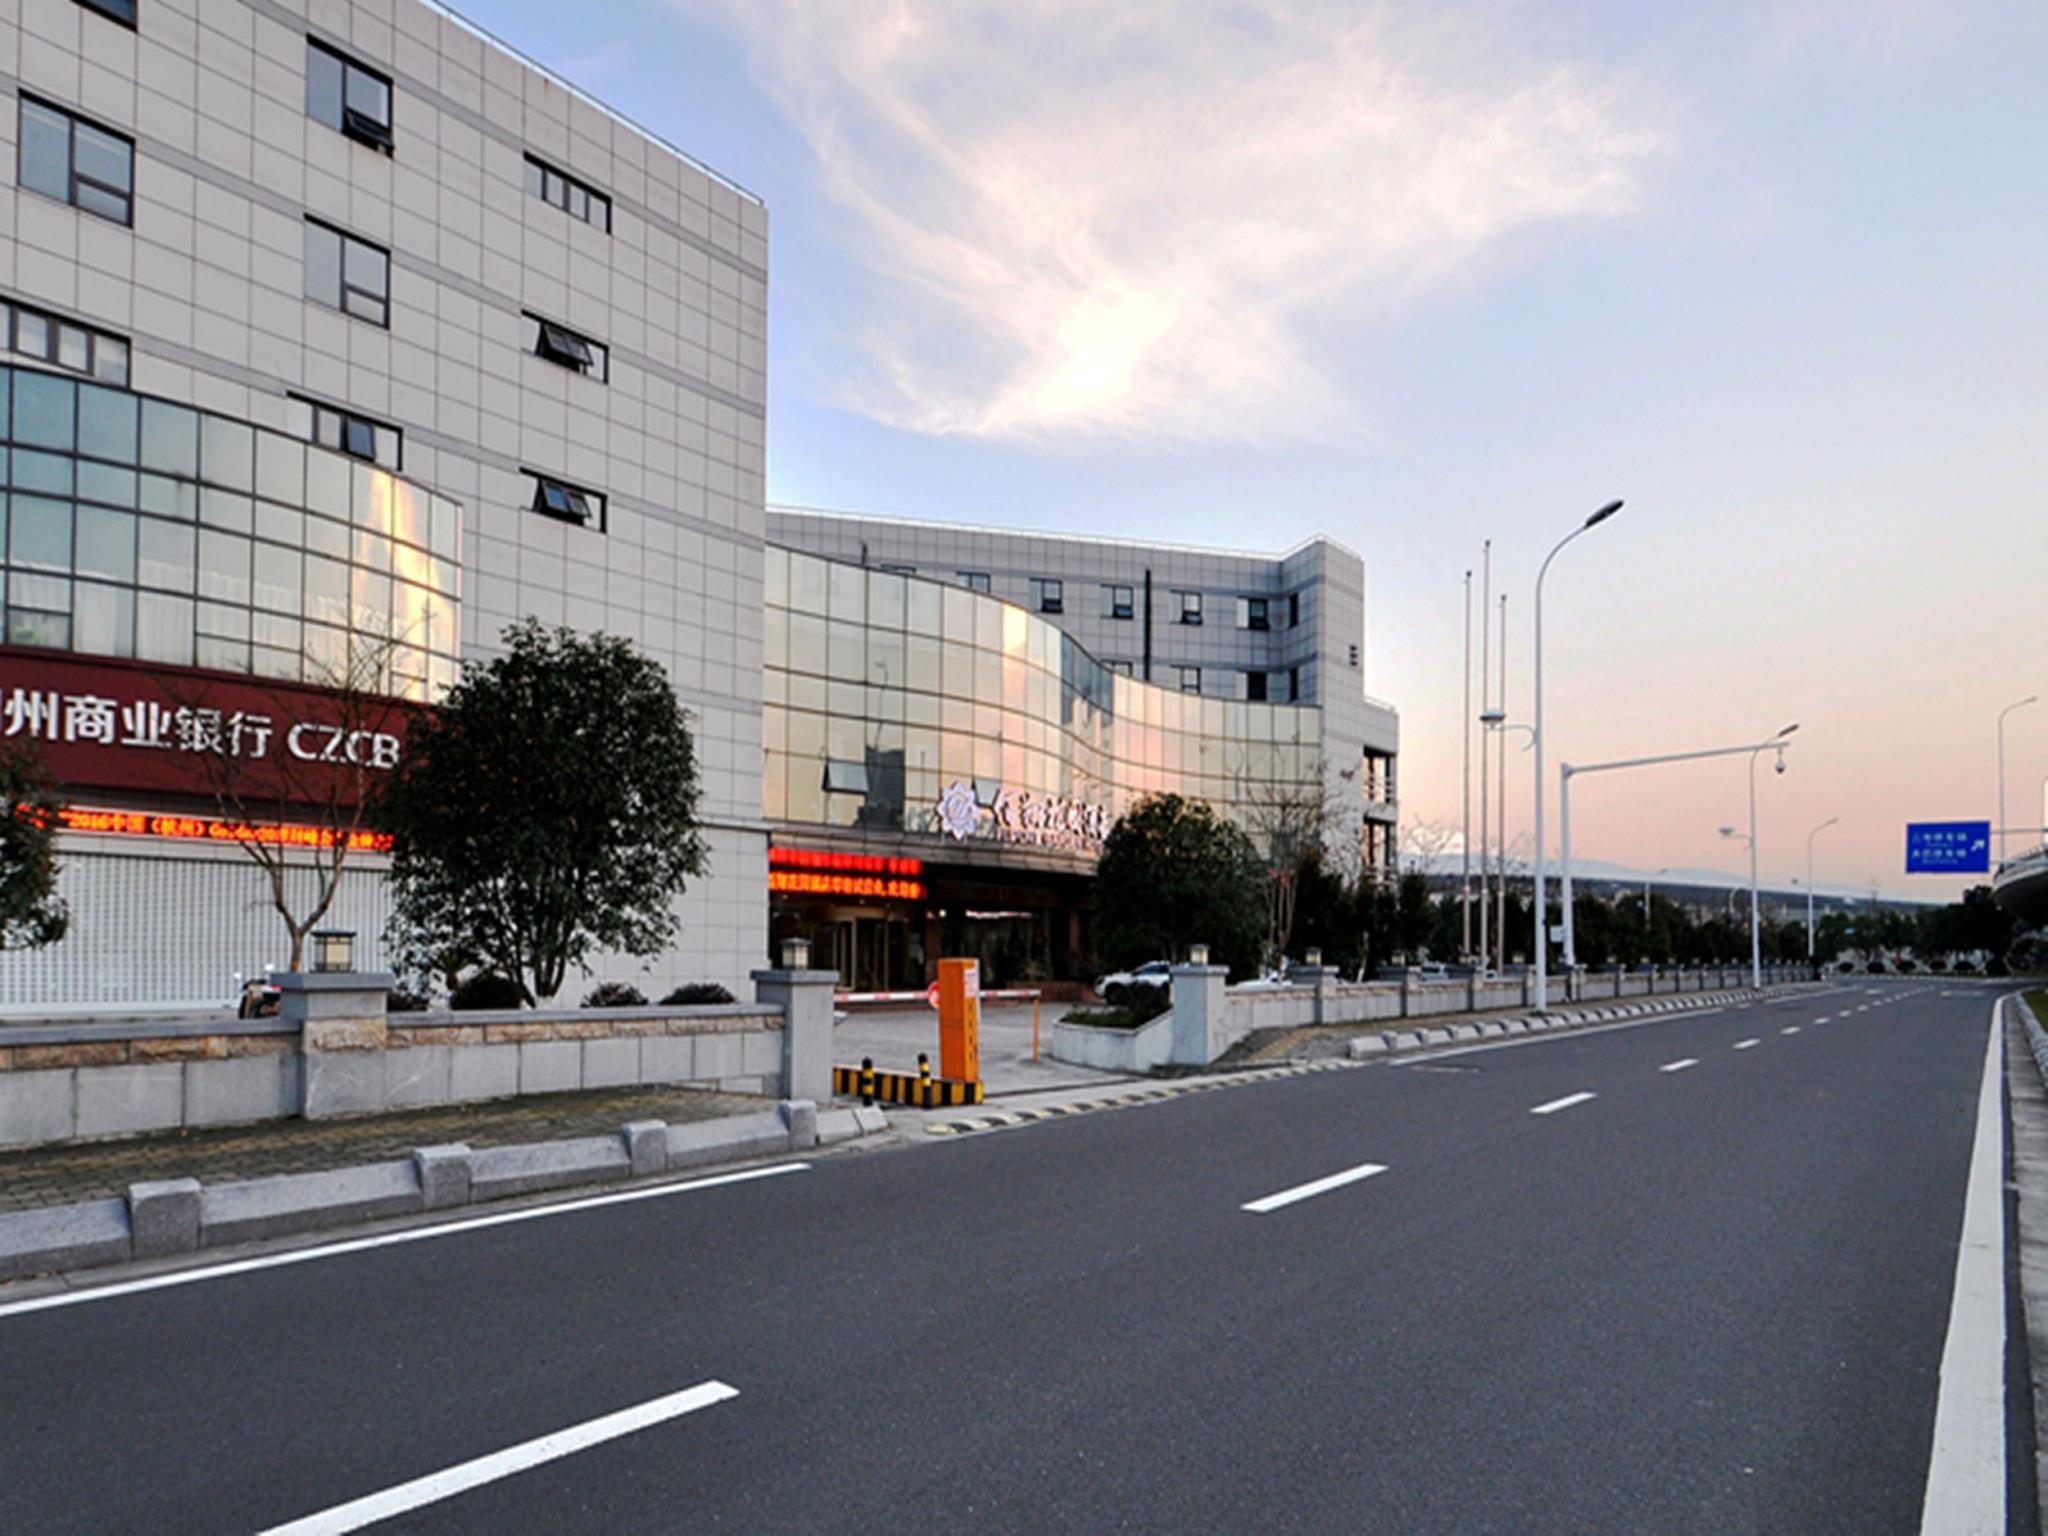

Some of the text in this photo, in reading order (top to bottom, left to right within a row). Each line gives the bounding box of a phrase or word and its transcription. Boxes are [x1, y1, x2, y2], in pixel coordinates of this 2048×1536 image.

[0, 687, 400, 770] 州商业银行 CZCB
